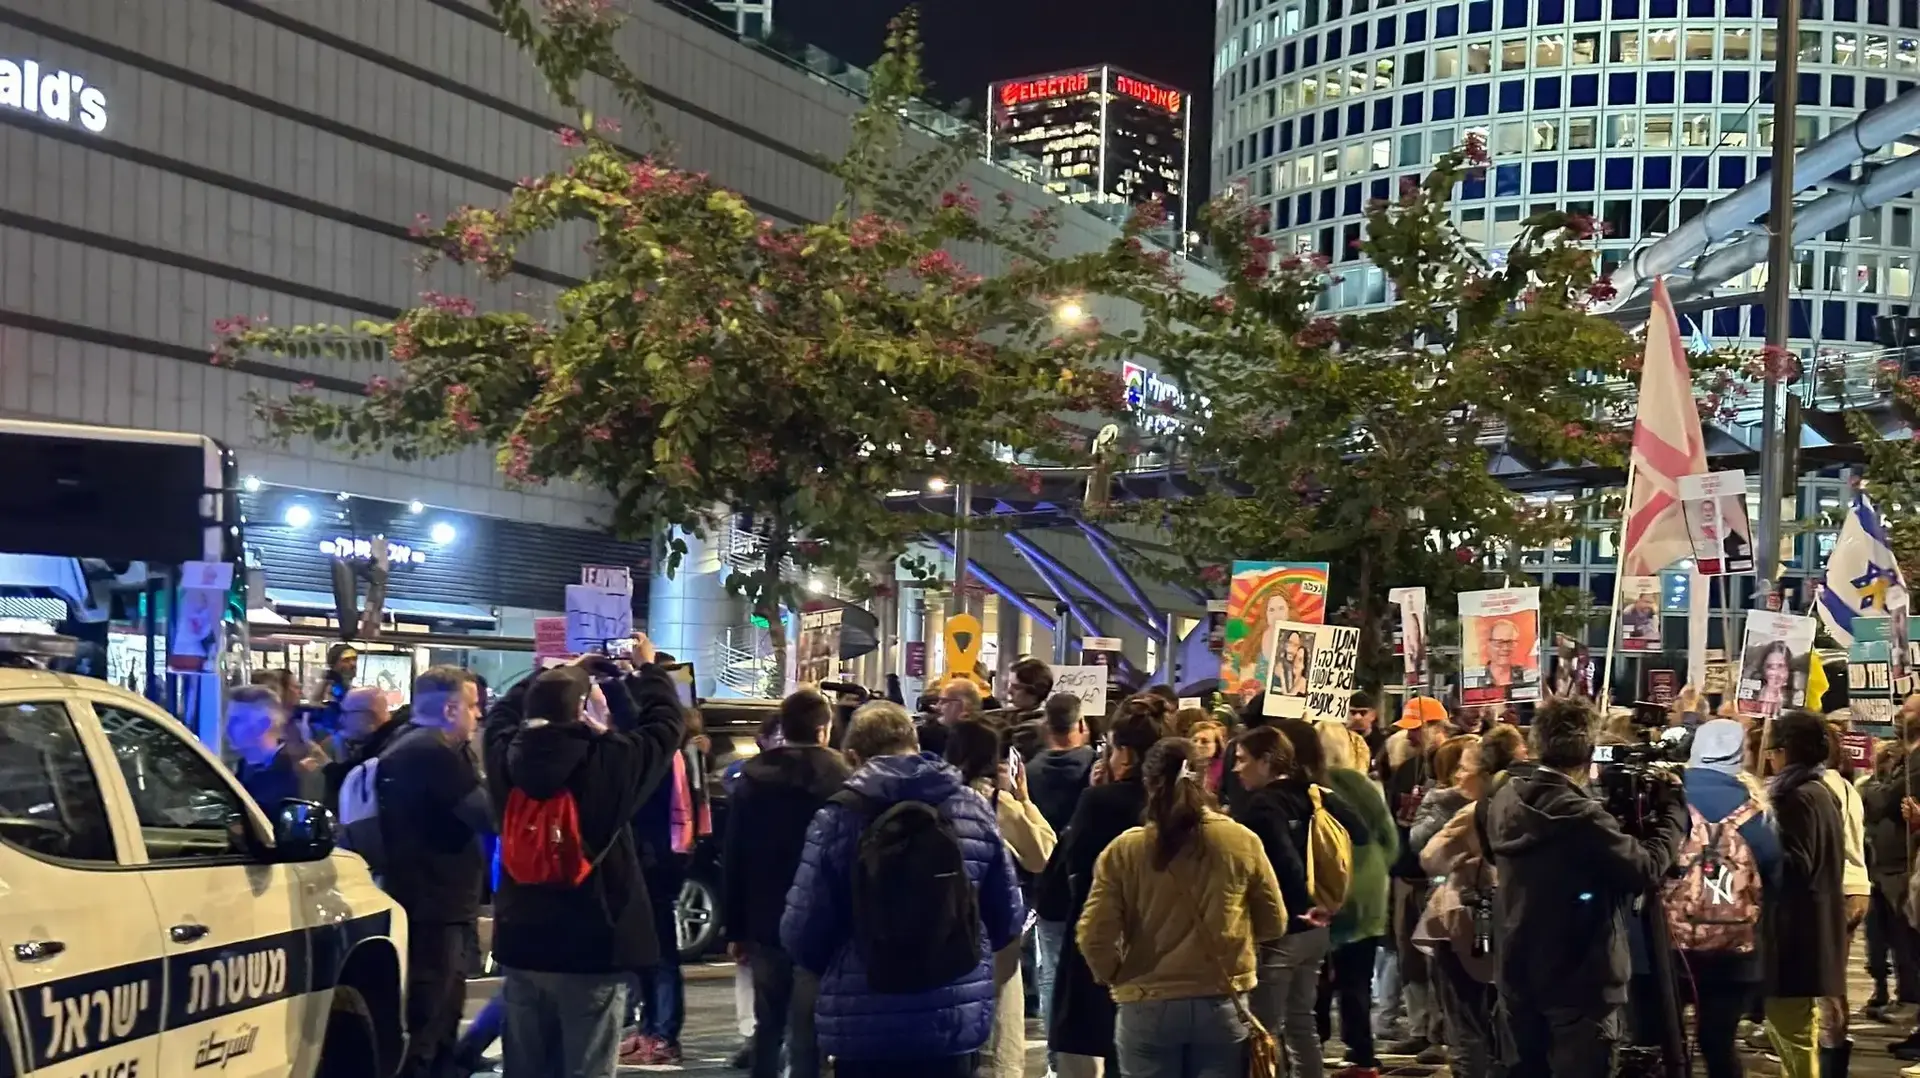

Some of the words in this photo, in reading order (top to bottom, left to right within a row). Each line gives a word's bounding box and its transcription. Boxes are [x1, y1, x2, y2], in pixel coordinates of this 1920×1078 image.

[0, 58, 108, 132] ald's
[1020, 73, 1089, 99] ELECTRA
[1117, 75, 1168, 107] אלקטרה
[1866, 662, 1890, 689] THE
[1703, 864, 1735, 905] NY
[187, 948, 287, 1015] משטרת
[41, 979, 149, 1059] ישראל
[194, 1022, 260, 1071] الشرطة
